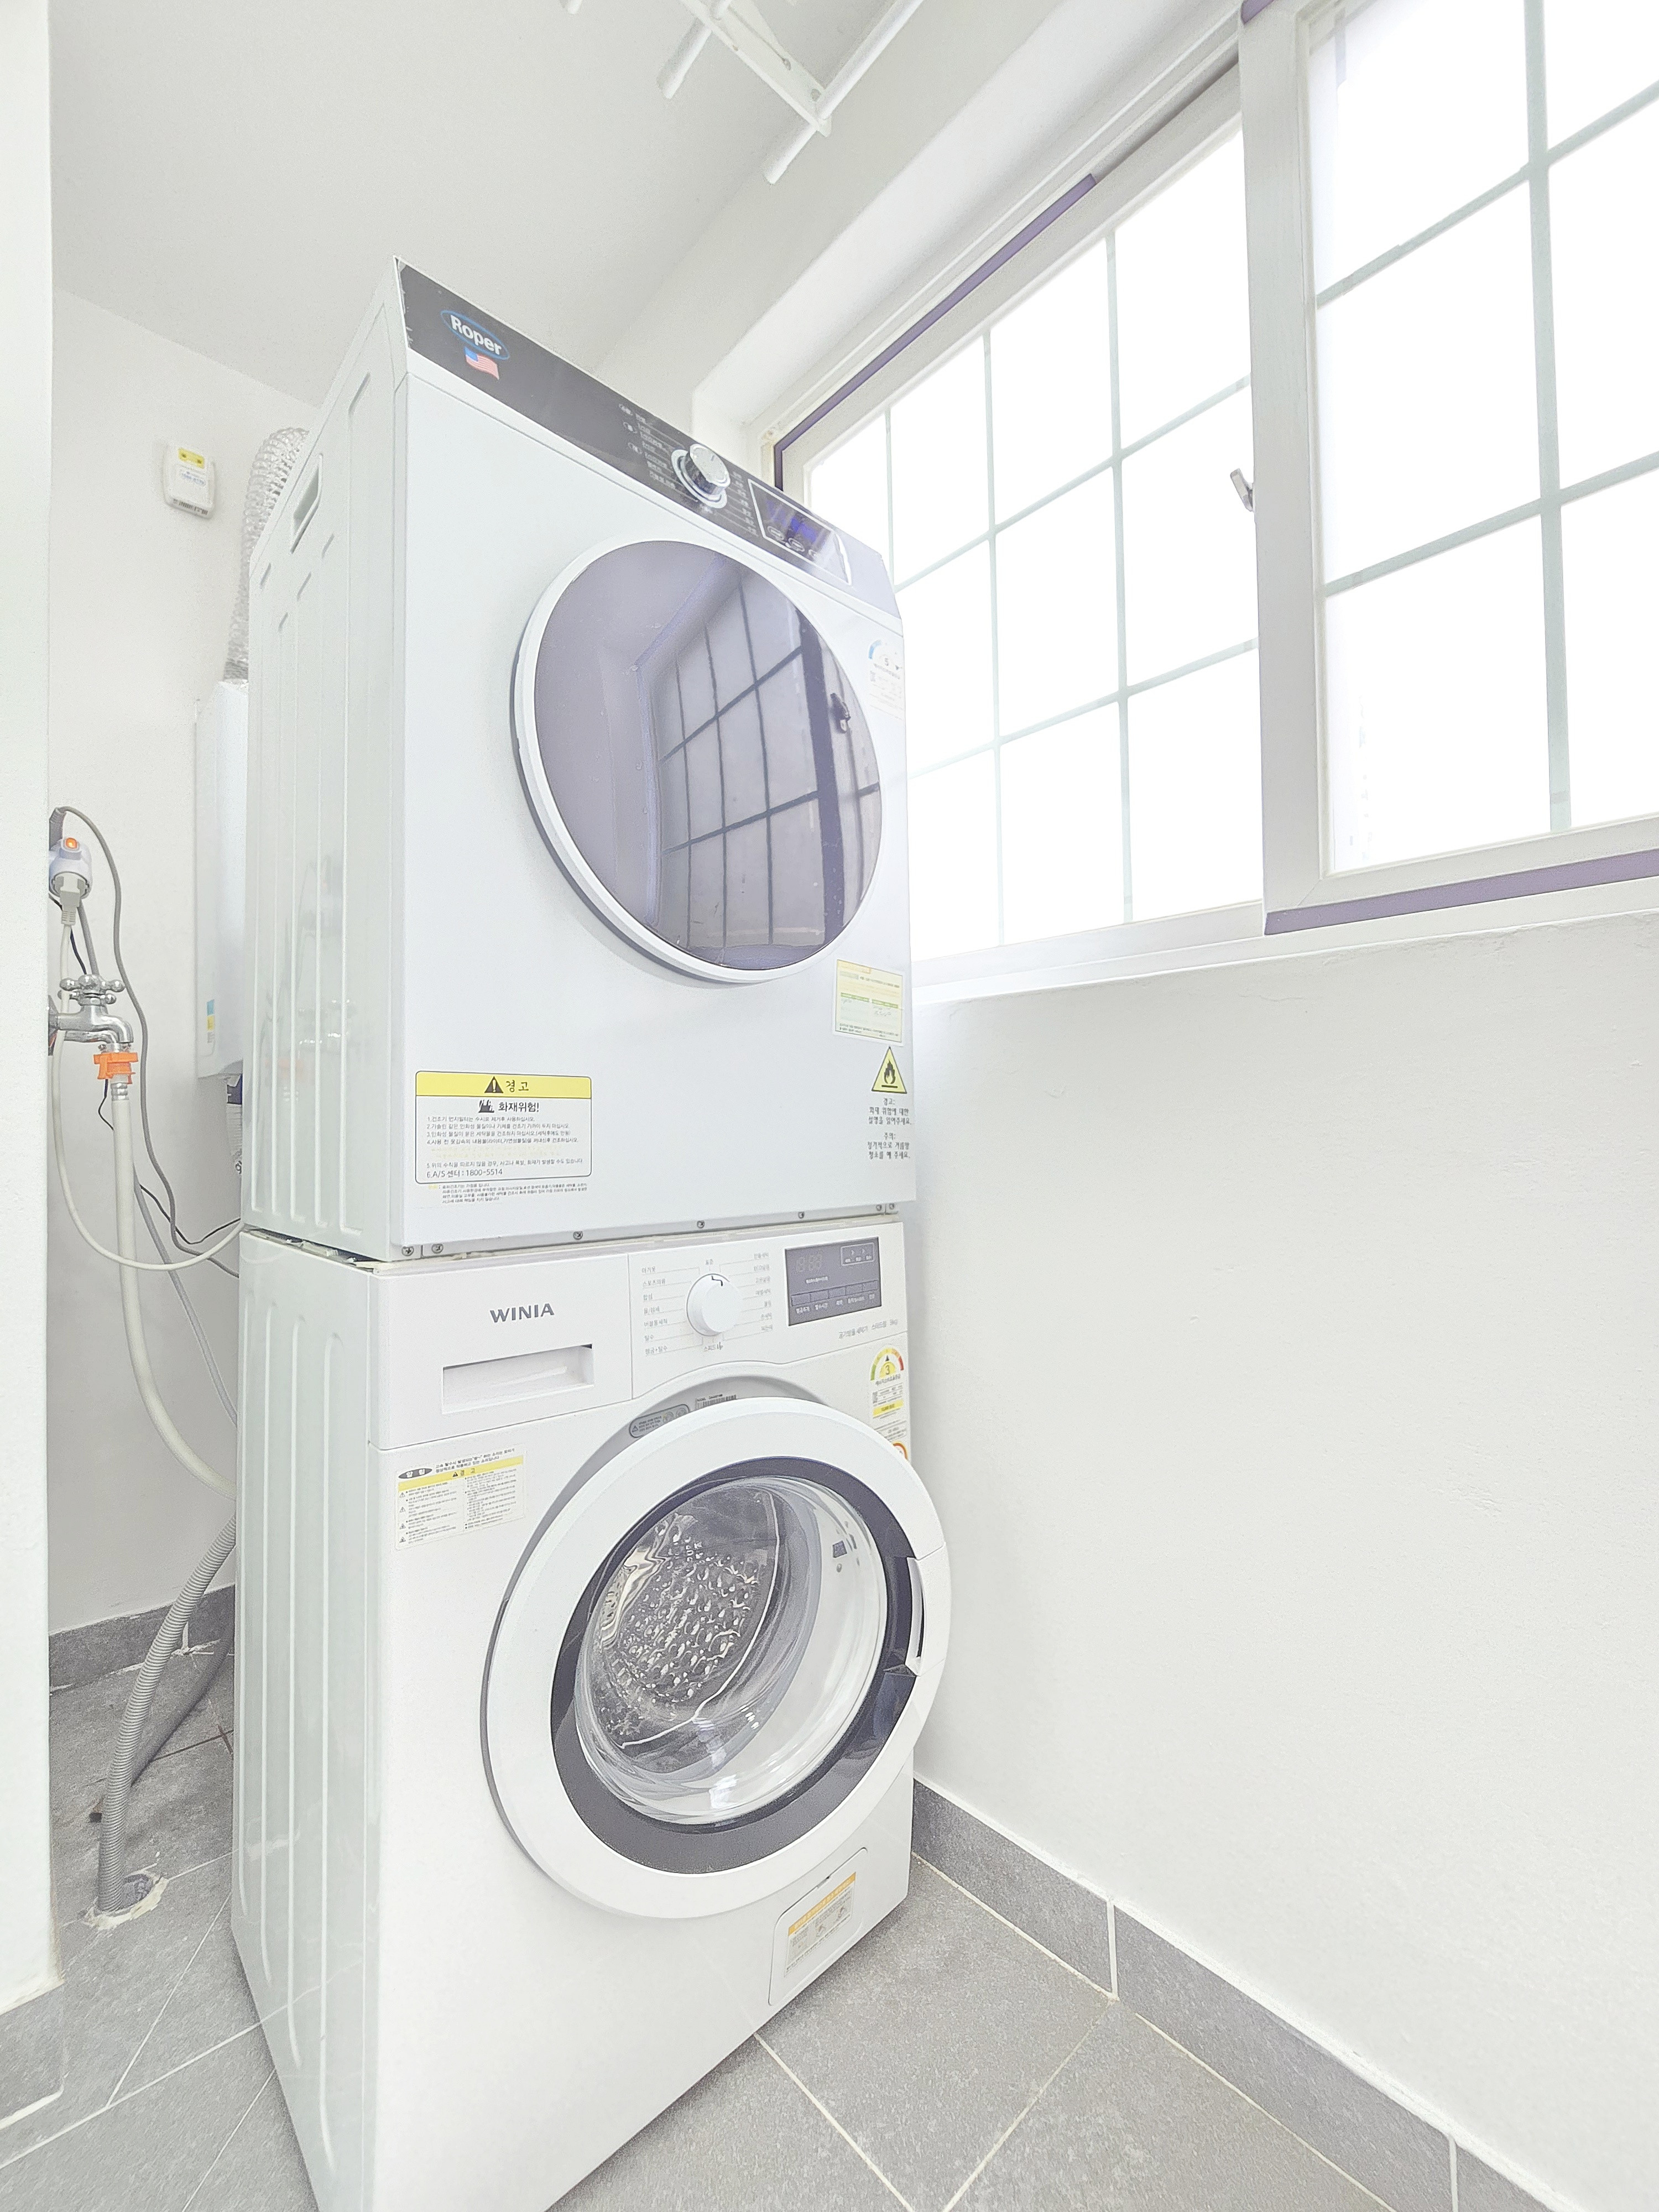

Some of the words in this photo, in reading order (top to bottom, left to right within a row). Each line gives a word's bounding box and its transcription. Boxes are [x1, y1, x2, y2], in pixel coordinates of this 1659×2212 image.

[450, 314, 502, 355] Roper
[505, 1079, 529, 1092] 경고
[498, 1102, 539, 1112] 화재위험!
[447, 1170, 460, 1178] 센터
[490, 1303, 555, 1323] WINIA
[885, 1365, 890, 1375] 3
